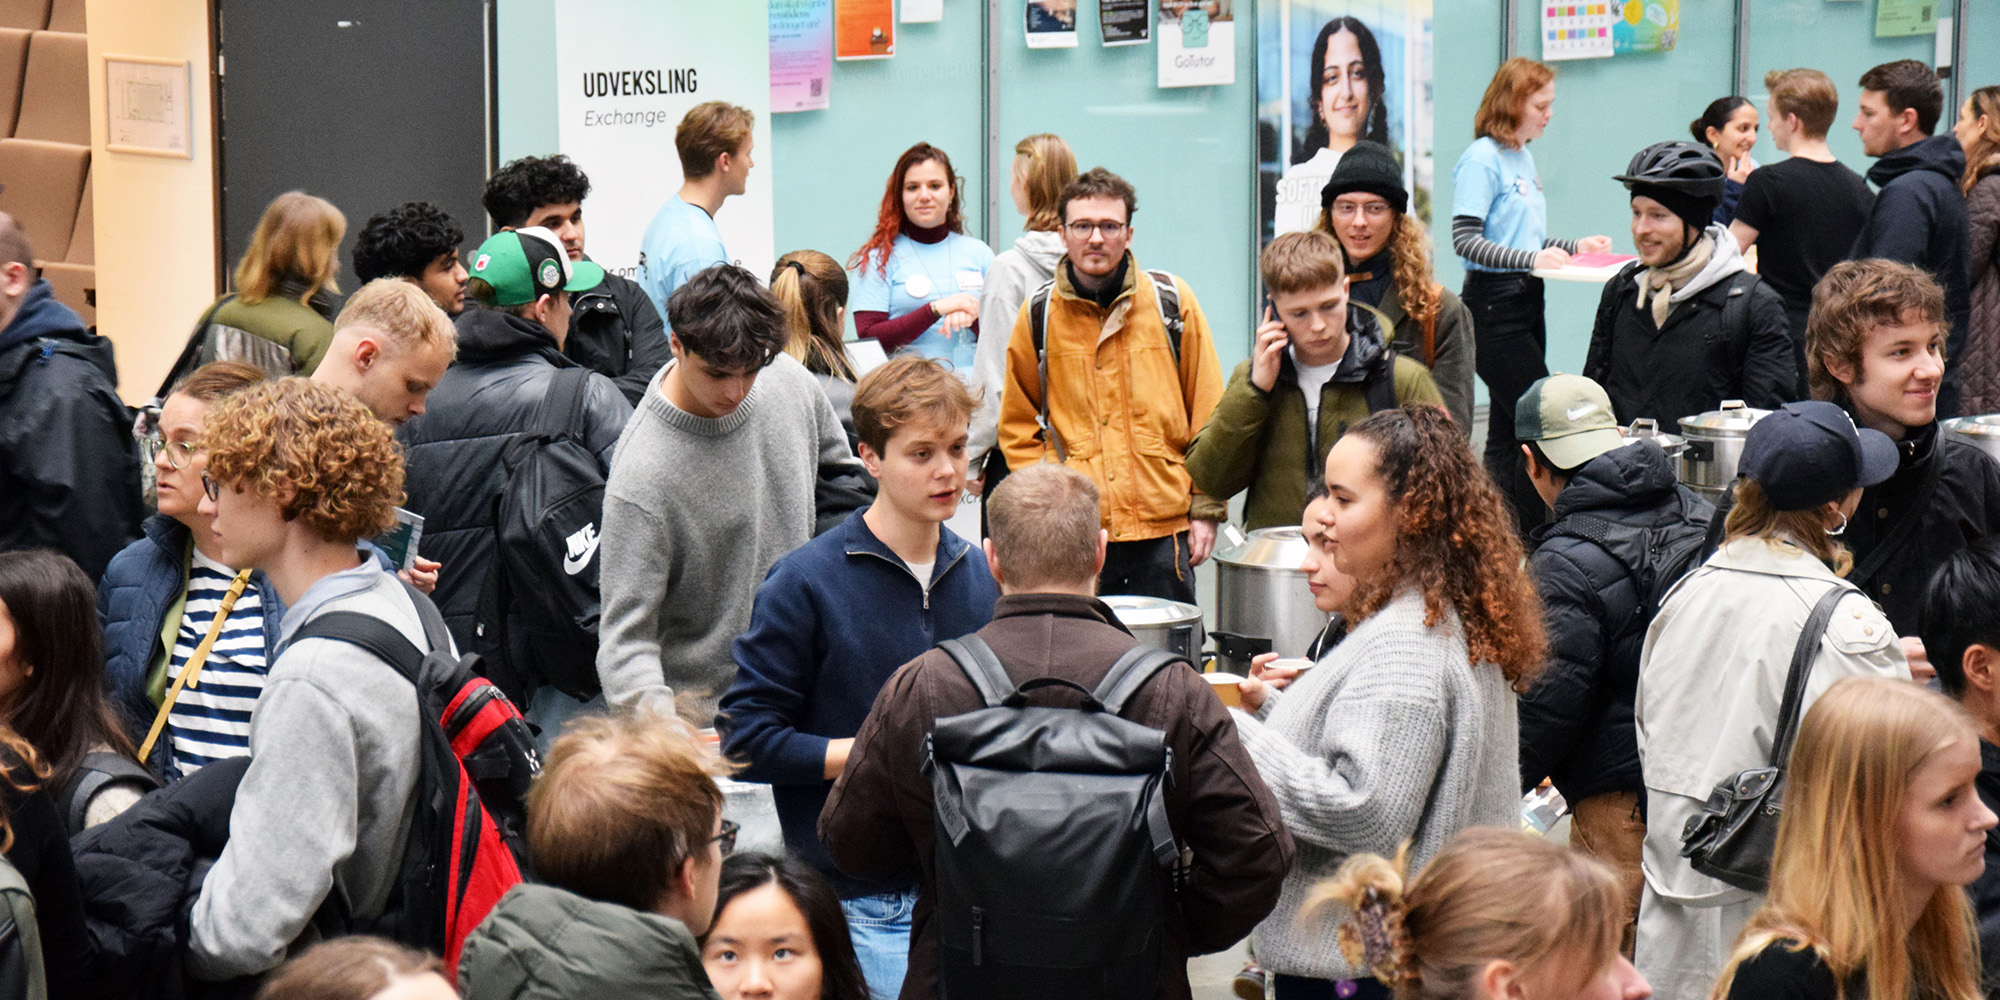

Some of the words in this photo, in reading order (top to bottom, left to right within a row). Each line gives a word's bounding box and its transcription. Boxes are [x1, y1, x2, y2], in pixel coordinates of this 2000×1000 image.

[1175, 54, 1216, 69] GoTutor
[583, 67, 698, 98] UDVEKSLING
[584, 108, 667, 128] Exchange
[565, 521, 599, 559] NIKE
